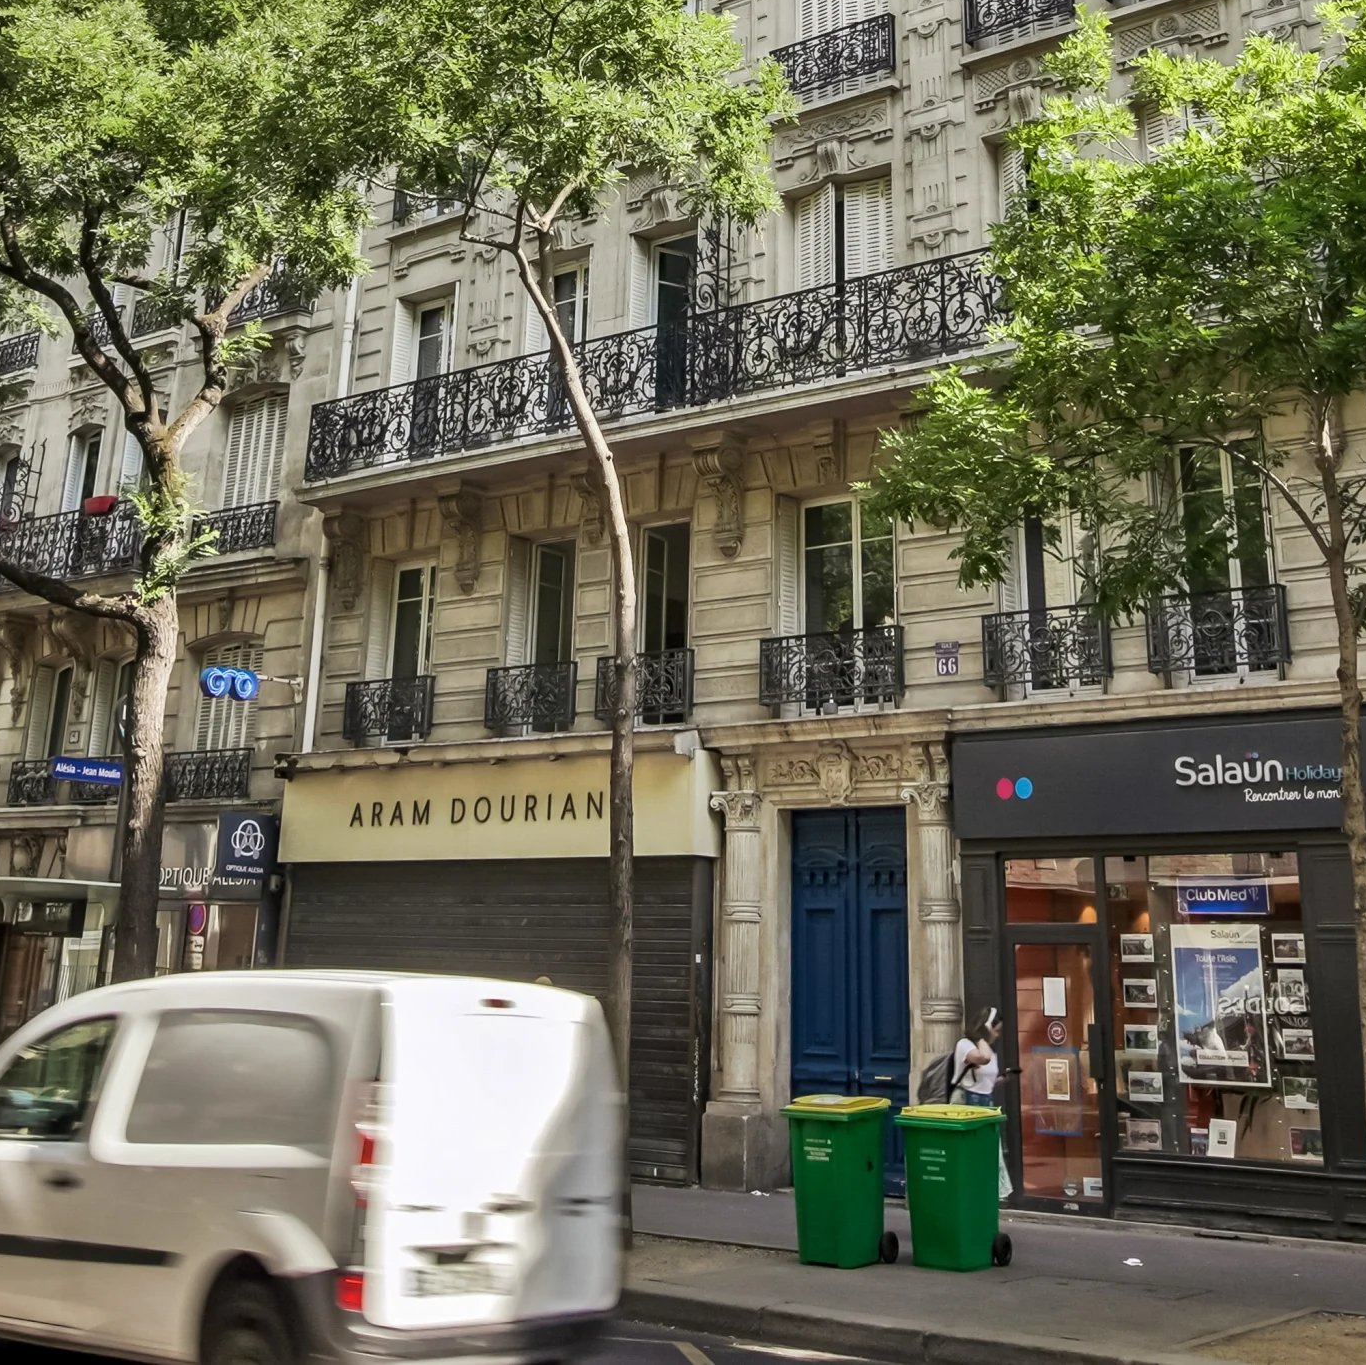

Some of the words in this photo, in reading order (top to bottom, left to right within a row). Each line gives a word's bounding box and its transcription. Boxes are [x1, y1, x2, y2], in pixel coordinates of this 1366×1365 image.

[938, 657, 957, 675] 66
[55, 762, 76, 774] Alésia
[82, 765, 97, 776] Jean
[98, 768, 121, 779] Moulin
[1173, 751, 1284, 786] Salaün
[1243, 787, 1302, 802] Rencontrer
[1303, 785, 1315, 799] le
[1316, 786, 1342, 800] mon
[349, 799, 431, 827] ARAM
[450, 791, 604, 824] DOURIAN
[225, 865, 247, 873] OPTIQUE
[247, 866, 264, 874] ALESIA
